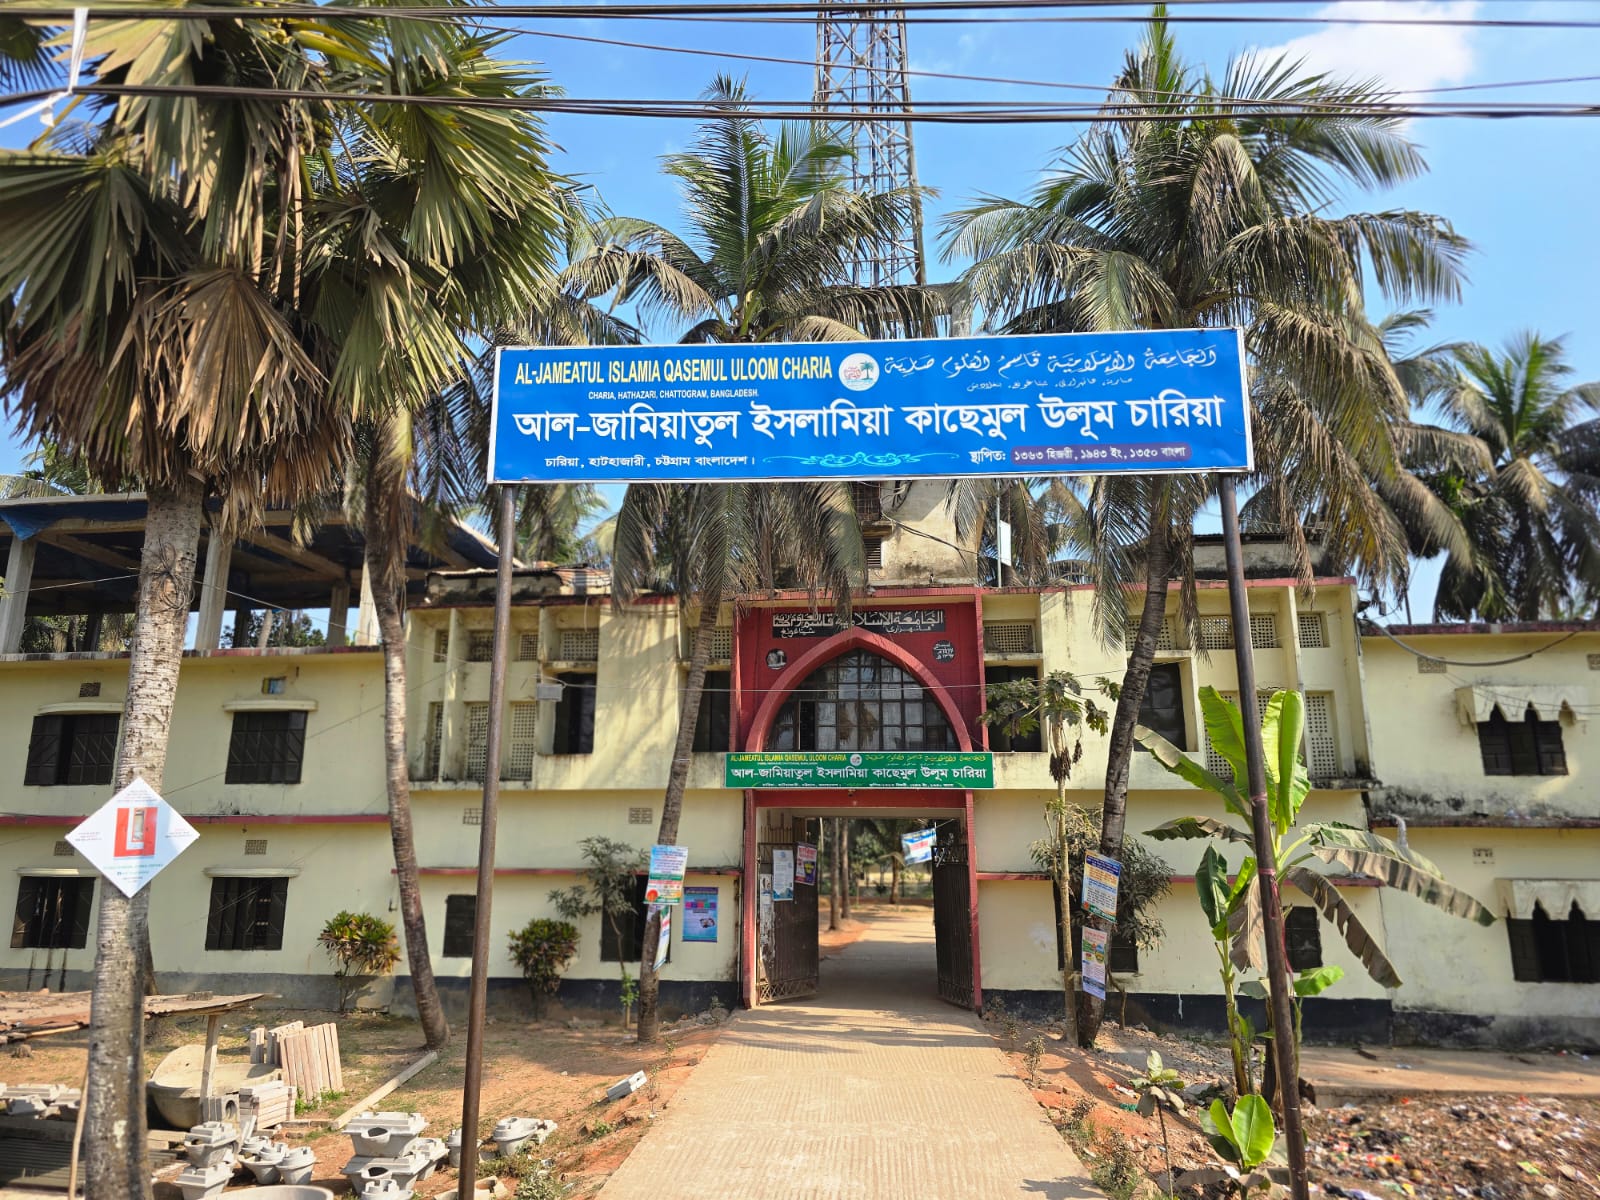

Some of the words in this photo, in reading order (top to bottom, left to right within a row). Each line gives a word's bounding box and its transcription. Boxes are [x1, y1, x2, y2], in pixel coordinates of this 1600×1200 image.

[514, 361, 603, 384] AL-JAMEATUL
[608, 360, 661, 383] ISLAMIA
[664, 358, 728, 382] QASEMUL
[731, 357, 779, 380] ULOOM
[782, 356, 832, 379] CHARIA
[588, 391, 616, 400] CHARIA,
[618, 390, 658, 400] HATHAZARI,
[660, 389, 709, 399] CHATTOGRAM,
[512, 402, 742, 449] আল-জামিয়াতুল
[749, 398, 894, 440] ইসলামিয়া
[902, 402, 1030, 441] কাছেমুল
[1036, 393, 1119, 441] উলূম
[1125, 389, 1225, 428] চারিয়া
[1014, 450, 1044, 461] ১৩৬৩
[1080, 448, 1107, 460] ১৯৪৩
[1130, 448, 1158, 459] ১৩৫০
[731, 766, 813, 780] আল-জামিয়াতুল
[816, 764, 868, 778] ইসলামিয়া
[872, 768, 917, 780] কাছেমুল
[952, 765, 987, 779] চারিয়া
